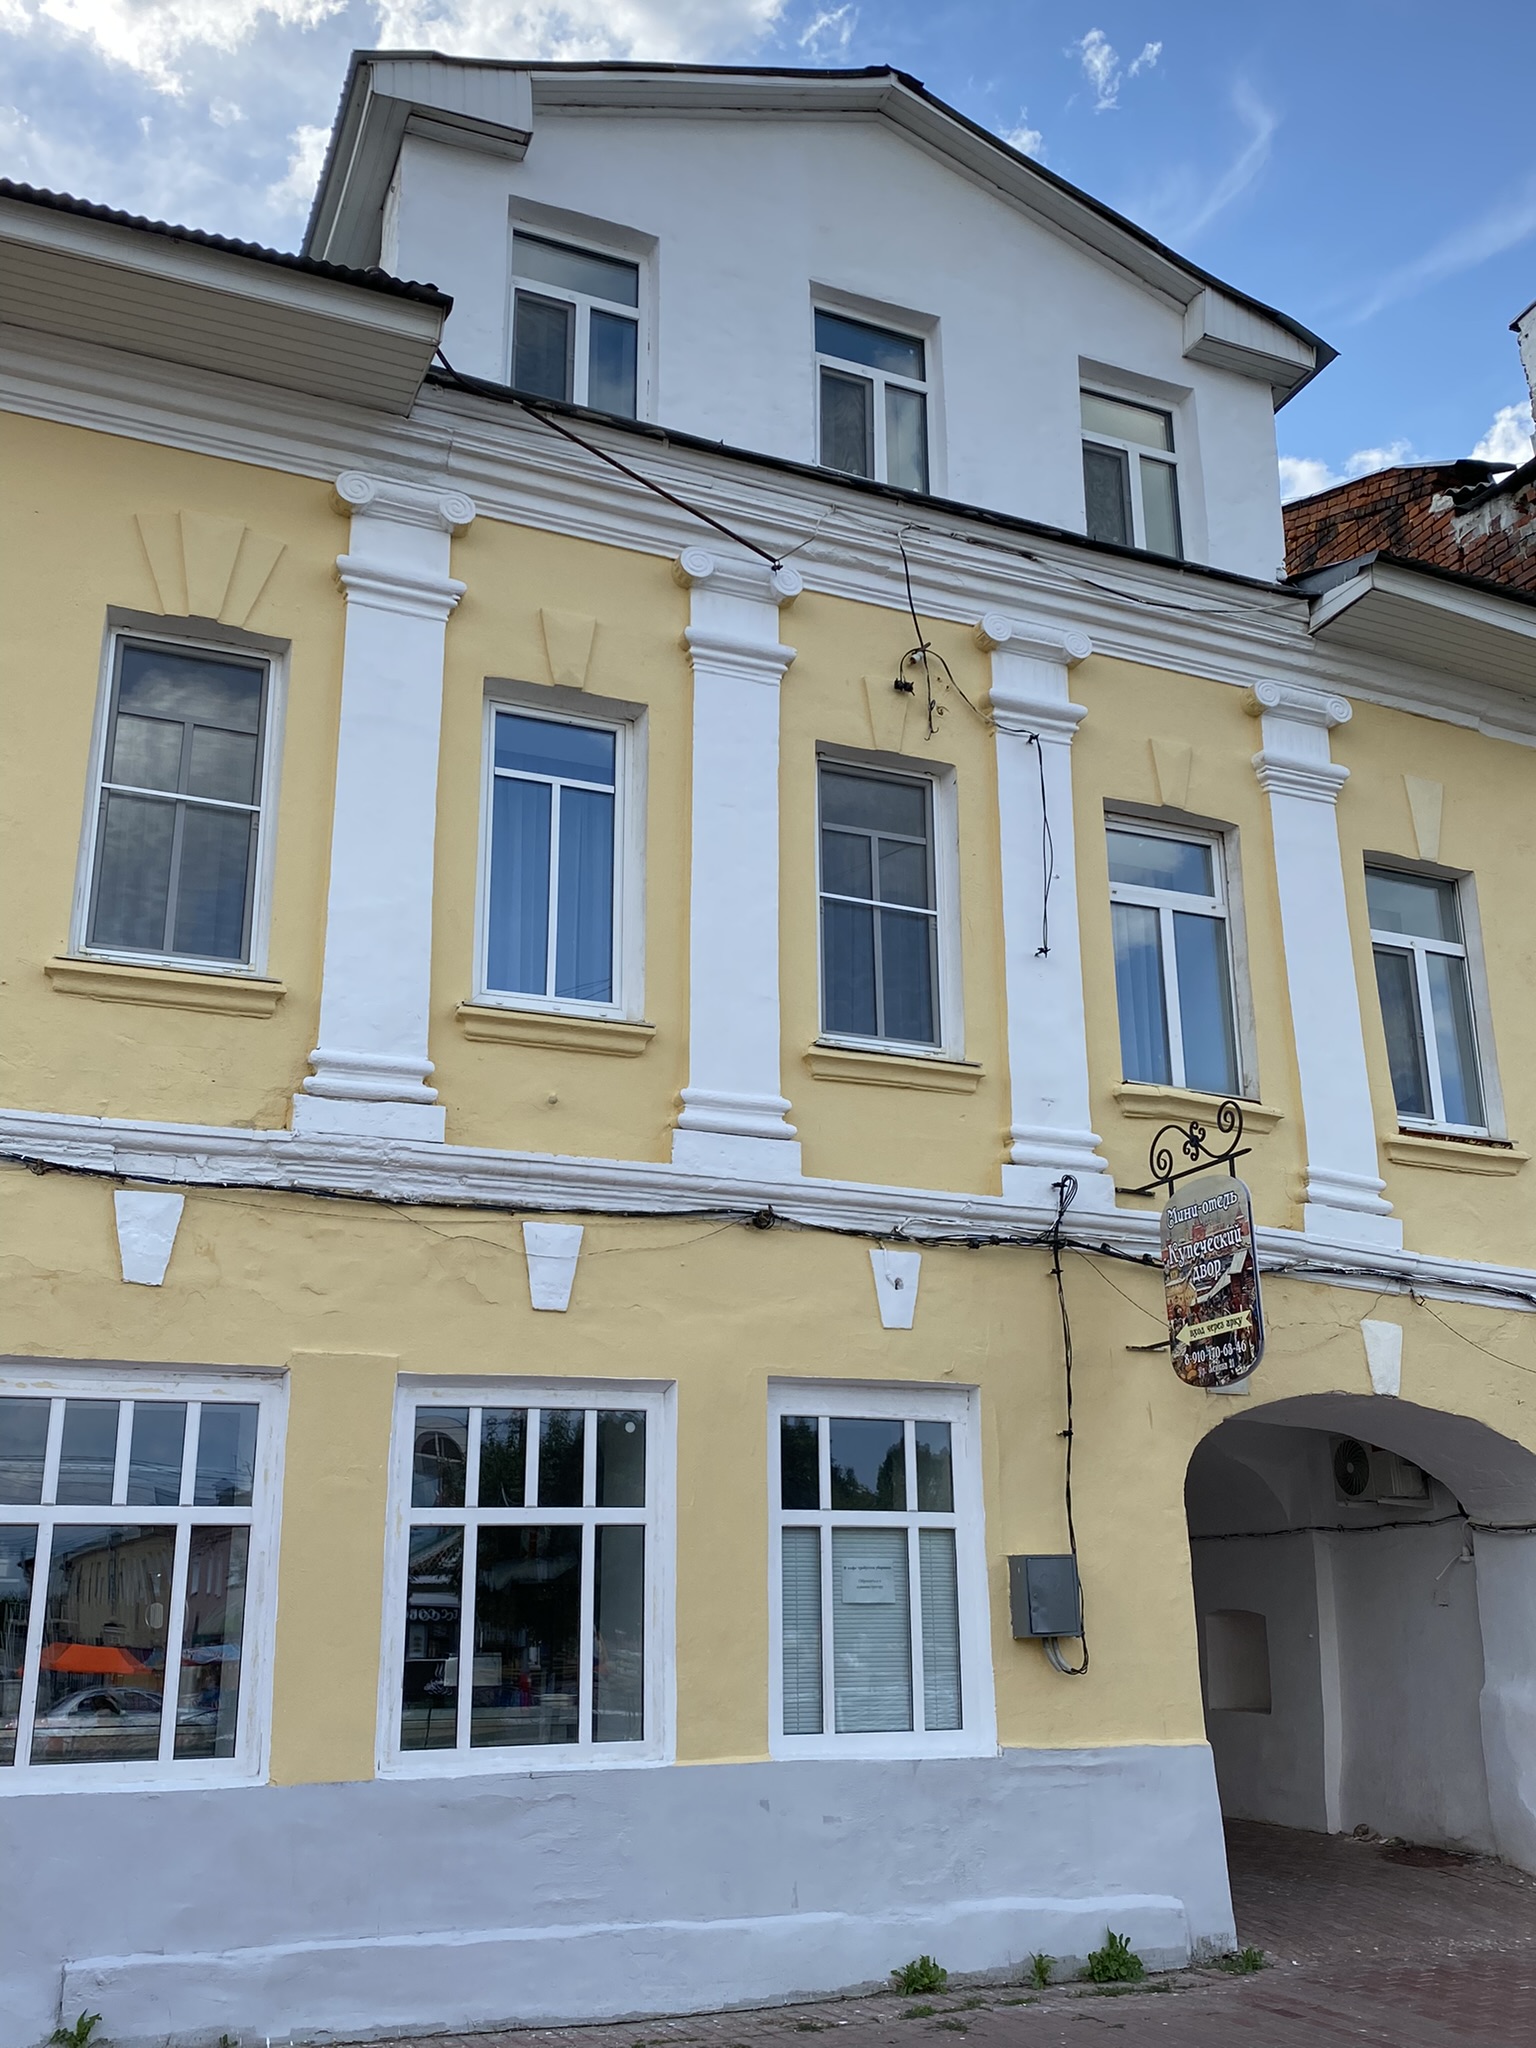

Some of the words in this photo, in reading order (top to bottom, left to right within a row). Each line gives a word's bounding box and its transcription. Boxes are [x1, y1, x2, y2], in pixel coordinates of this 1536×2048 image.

[1167, 1191, 1238, 1229] Мини-отель
[1168, 1223, 1243, 1268] Купеческий
[1207, 1321, 1225, 1333] через
